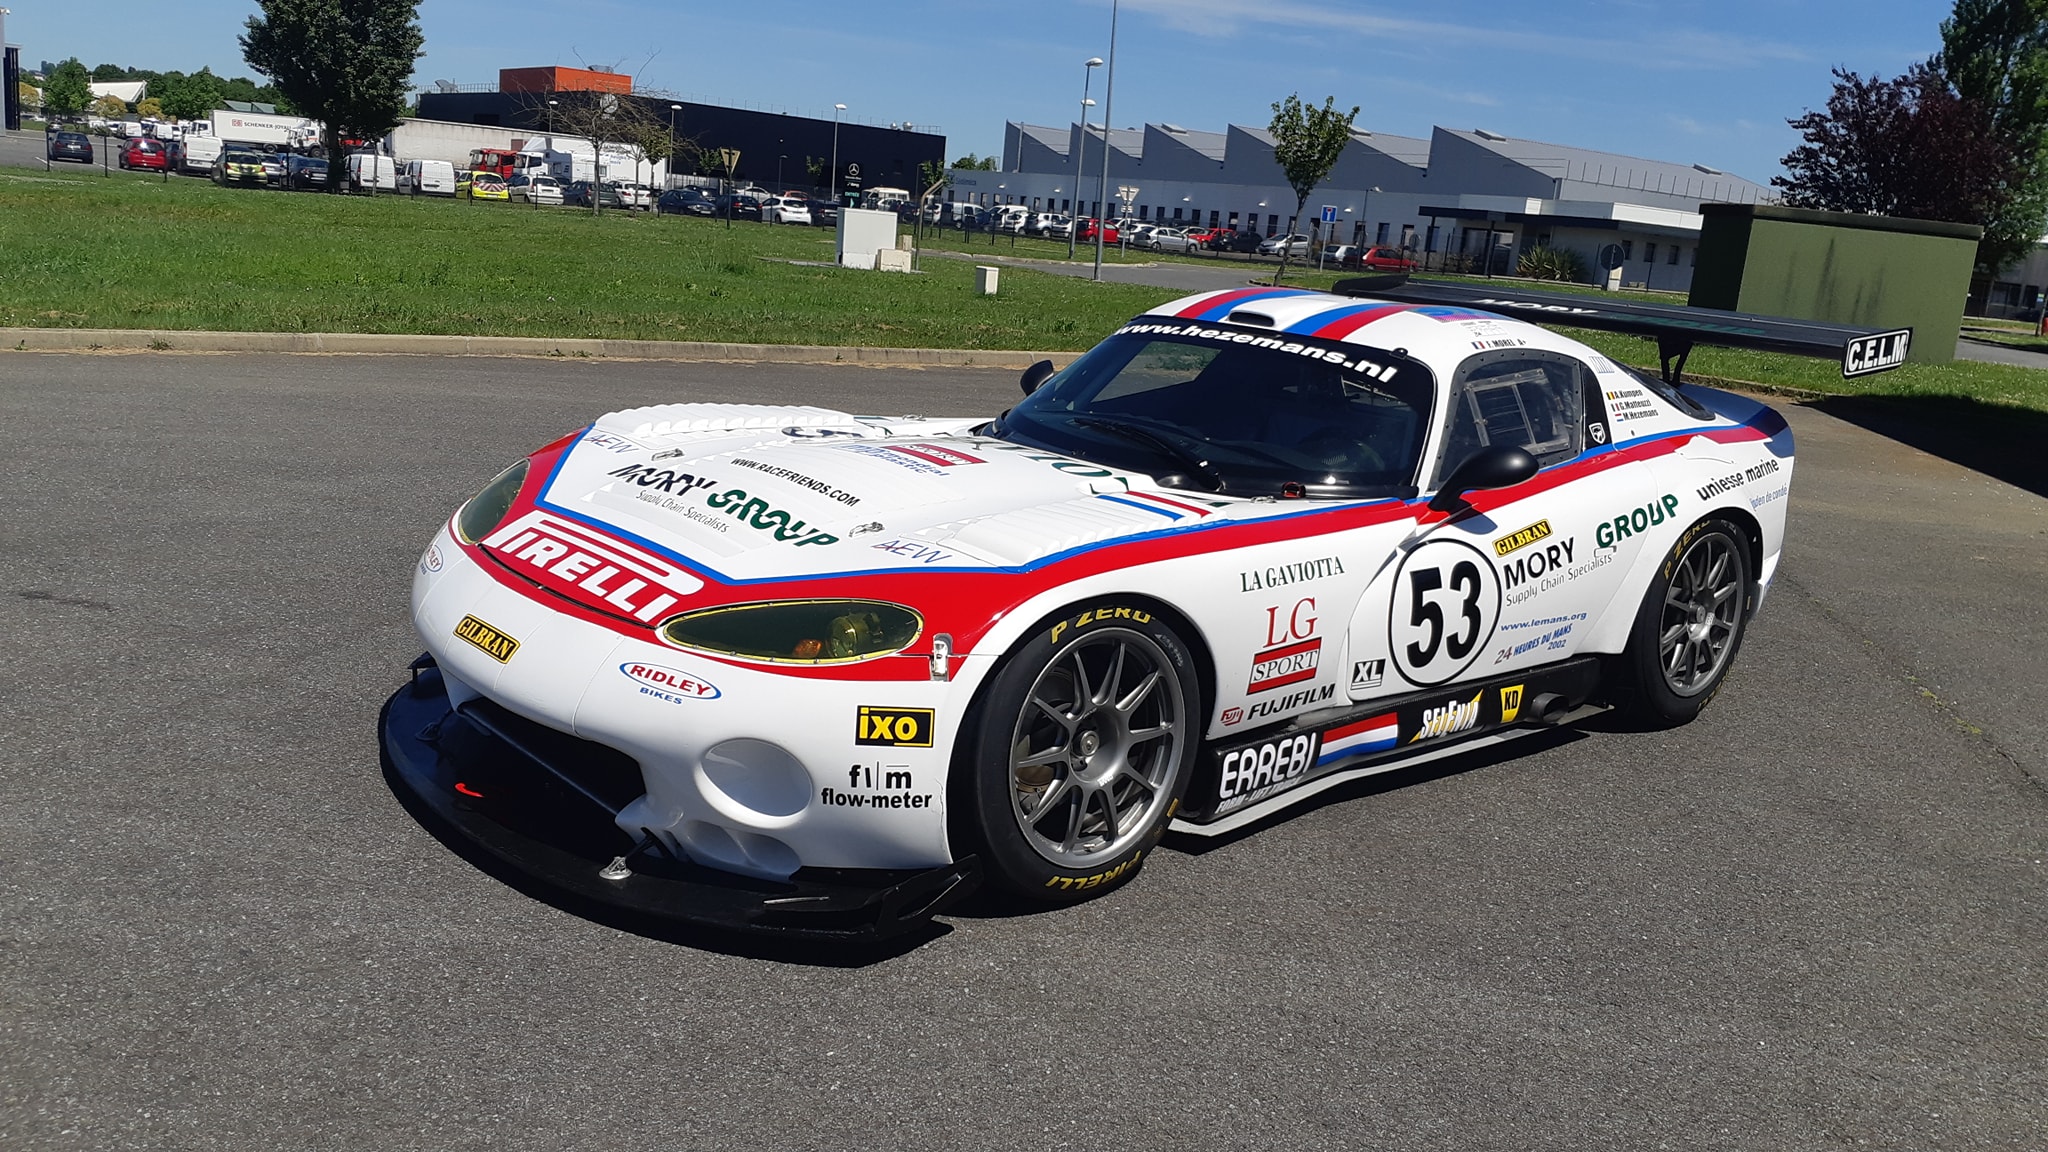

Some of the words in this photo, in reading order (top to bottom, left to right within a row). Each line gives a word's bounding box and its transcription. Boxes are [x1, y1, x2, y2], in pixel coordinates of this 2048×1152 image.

[1472, 299, 1599, 314] MORY
[1114, 324, 1397, 383] www.hezemans.nl
[731, 457, 861, 507] WWW.RACEFRIENDS.COM
[1696, 472, 1744, 501] uniesse
[1745, 459, 1780, 482] marine
[607, 463, 718, 496] MORY
[707, 489, 840, 547] GROUP
[636, 490, 662, 508] Supply
[662, 497, 685, 514] Chain
[683, 506, 730, 534] Specialists
[1496, 522, 1549, 554] GILBRAN
[1503, 536, 1575, 590] MORY
[1596, 493, 1679, 549] GROUP
[481, 509, 705, 622] PIRELLI
[1240, 570, 1263, 593] LA
[1265, 556, 1345, 589] GAVIOTTA
[1506, 585, 1538, 607] Supply
[1540, 573, 1565, 592] Chain
[1567, 554, 1613, 581] Specialists
[1051, 620, 1068, 644] P
[1263, 597, 1318, 648] LG
[1406, 560, 1482, 669] 53
[1500, 612, 1588, 632] www.lemans.org
[457, 617, 515, 659] GILBRAN
[1493, 646, 1513, 665] 24
[1513, 637, 1541, 657] HEURES
[1540, 632, 1551, 645] DU
[1551, 623, 1573, 641] MANS
[1547, 639, 1567, 651] 2002
[629, 664, 713, 697] RIDLEY
[1252, 650, 1318, 682] SPORT
[1353, 660, 1383, 683] XL
[639, 687, 683, 705] BIKES
[1247, 683, 1336, 720] FUJIFILM
[1504, 690, 1519, 711] KD
[859, 707, 918, 741] ixo
[1219, 732, 1317, 800] ERREBI
[821, 787, 933, 809] flow-meter
